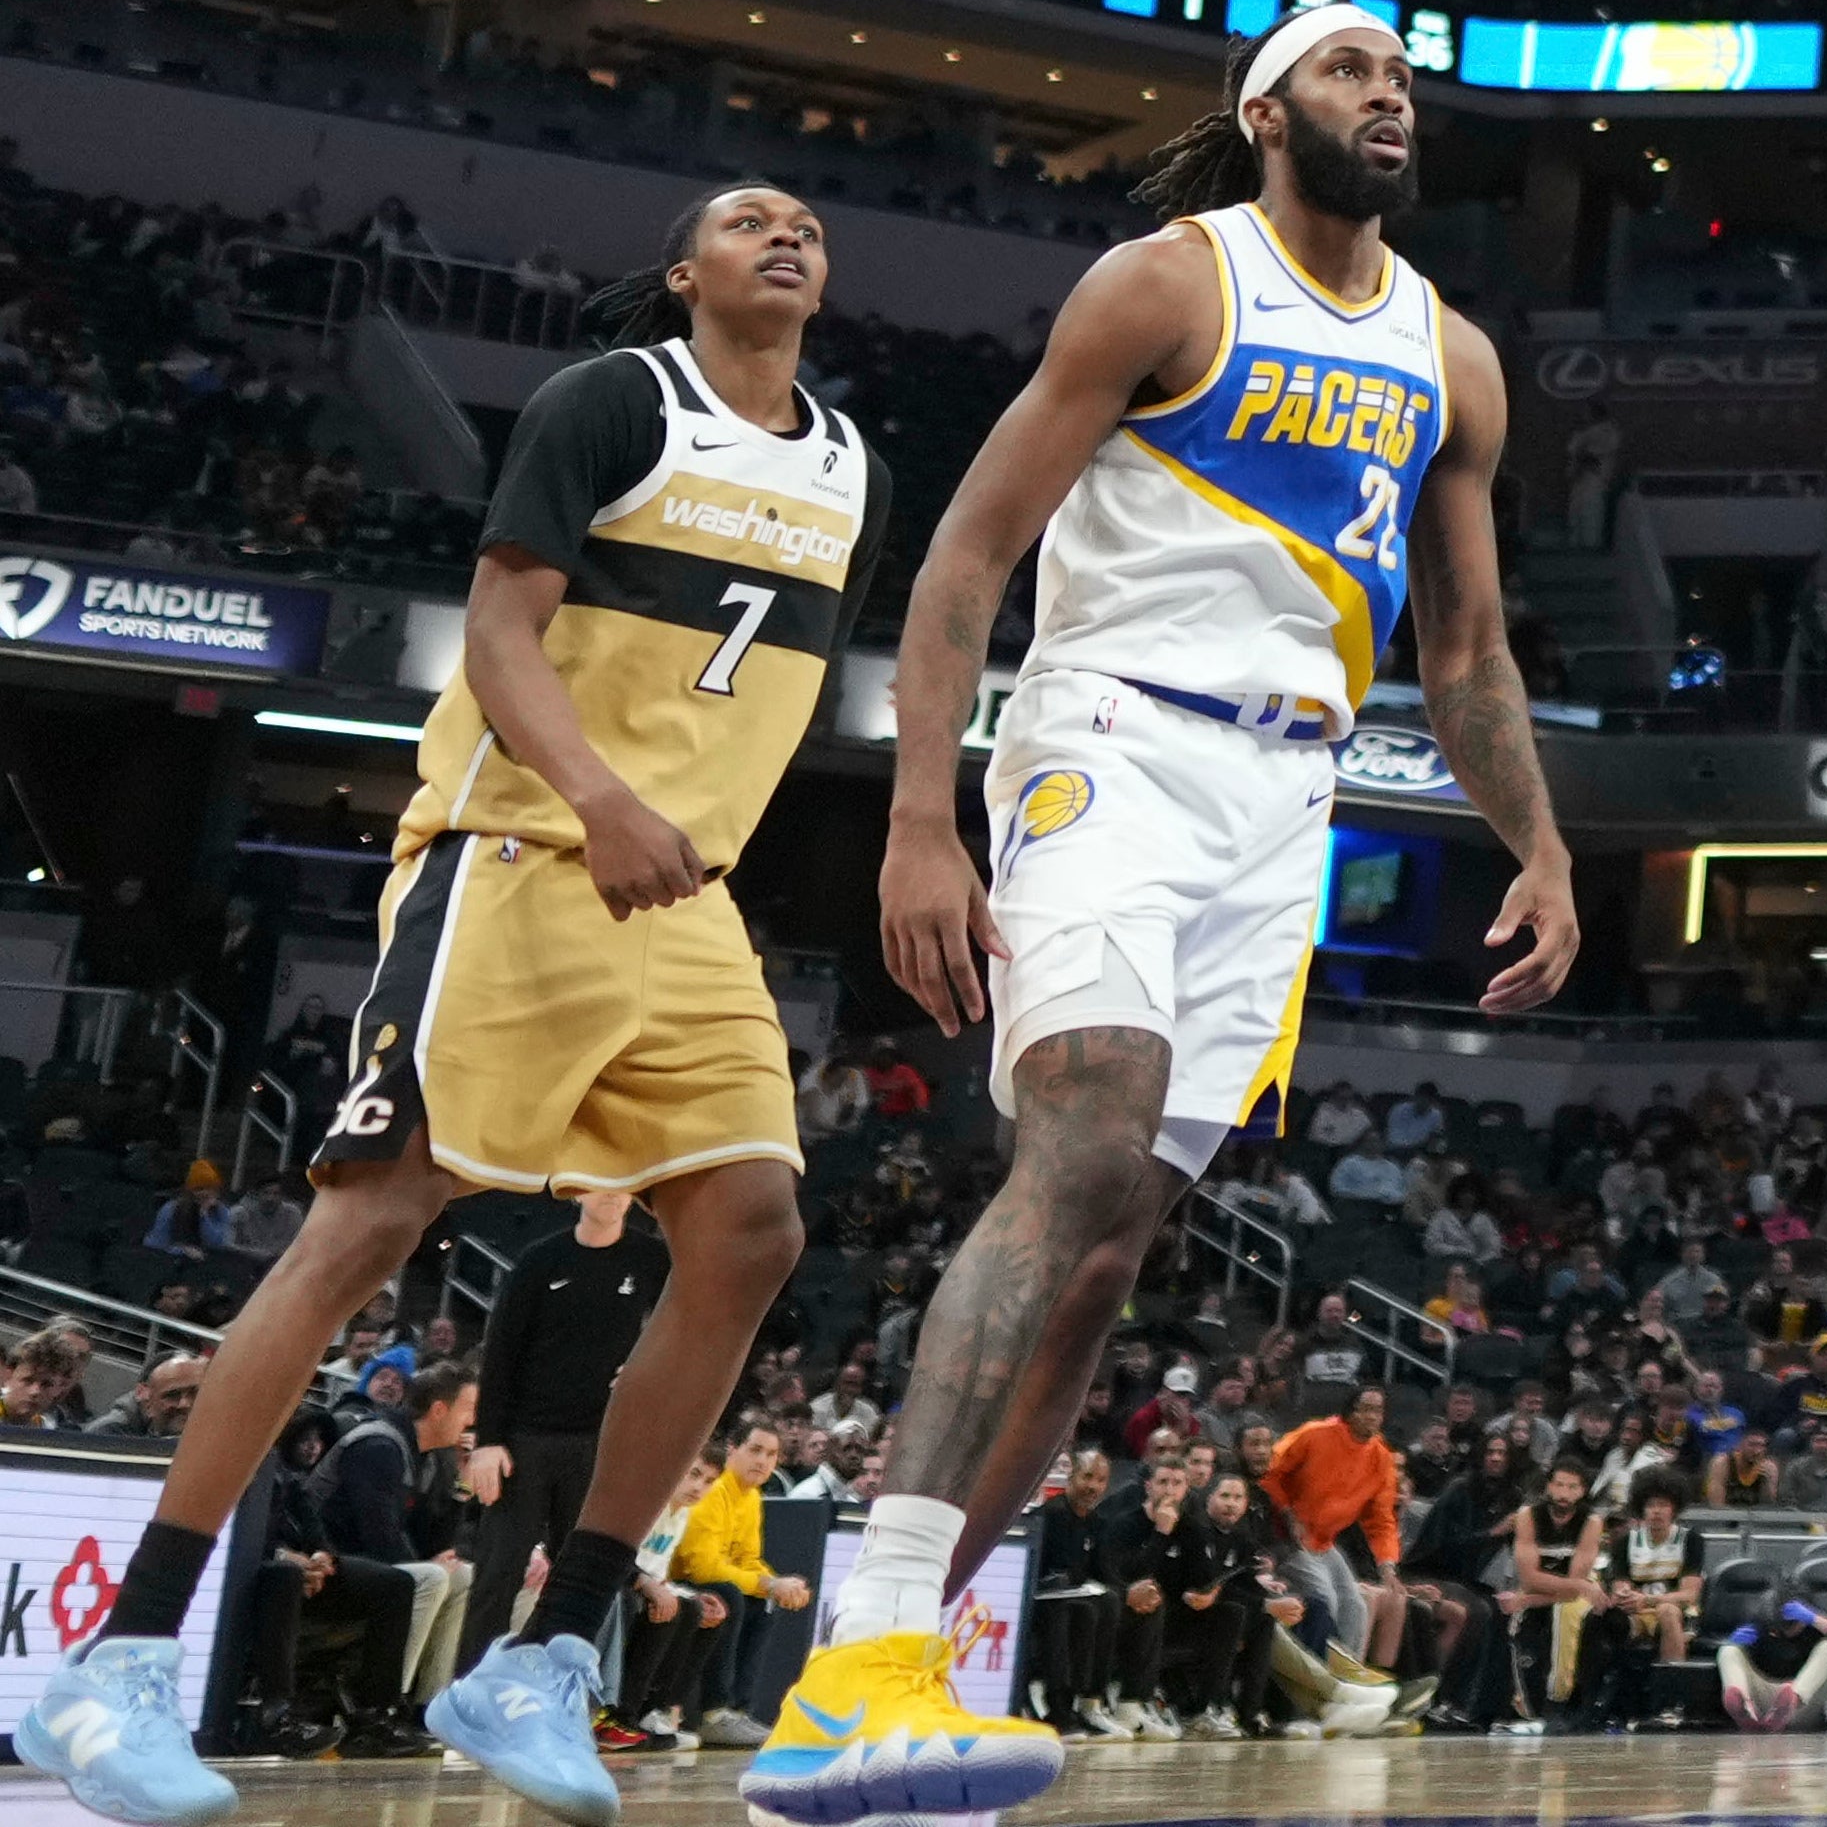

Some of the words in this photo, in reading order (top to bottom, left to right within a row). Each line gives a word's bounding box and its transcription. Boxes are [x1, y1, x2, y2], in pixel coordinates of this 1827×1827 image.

[1405, 31, 1454, 71] 36
[1615, 356, 1818, 386] LEXUS
[1226, 361, 1431, 469] PACERS
[662, 496, 850, 566] washington
[82, 576, 274, 628] FANDUEL
[78, 612, 161, 643] SPORTS
[163, 623, 270, 652] NETWORK
[693, 579, 777, 697] 7
[1342, 731, 1442, 783] Ford
